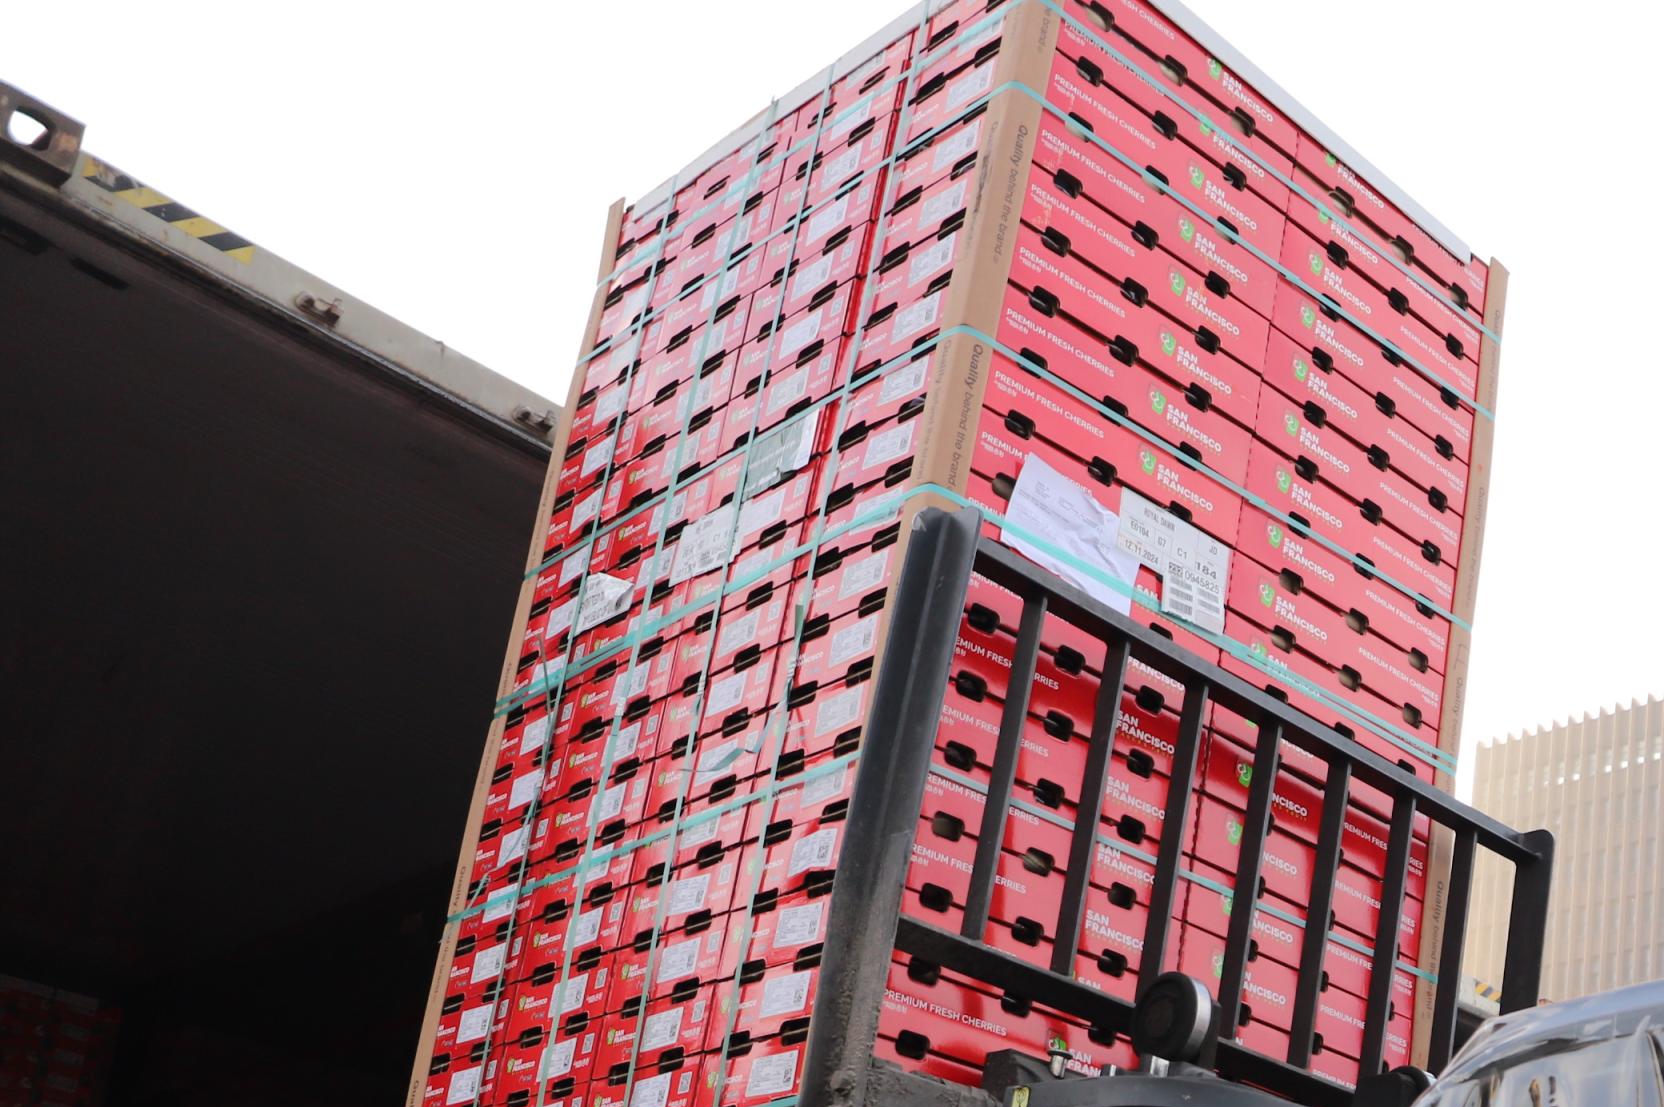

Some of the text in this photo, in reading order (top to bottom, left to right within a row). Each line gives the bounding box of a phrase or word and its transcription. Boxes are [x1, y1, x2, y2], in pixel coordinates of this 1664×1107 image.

[1138, 7, 1175, 40] CHERRIES
[1222, 72, 1243, 91] SAN
[1055, 74, 1092, 106] PREMIUM
[1093, 98, 1118, 124] FRESH
[1119, 117, 1157, 149] CHERRIES
[1221, 80, 1274, 122] FRANCISCO
[1010, 124, 1028, 167] Quality
[1212, 135, 1265, 178] FRANCISCO
[1042, 129, 1080, 161] PREMIUM
[1081, 155, 1106, 181] FRESH
[1107, 173, 1145, 203] CHERRIES
[1205, 180, 1225, 198] SAN
[1337, 166, 1385, 209] FRANCISCO
[1031, 184, 1069, 215] PREMIUM
[1070, 209, 1097, 235] FRESH
[1098, 227, 1136, 257] CHERRIES
[1205, 189, 1258, 230] FRANCISCO
[1195, 233, 1216, 252] SAN
[1331, 222, 1378, 264] FRANCISCO
[1195, 242, 1248, 283] FRANCISCO
[1324, 267, 1343, 284] SAN
[1020, 247, 1058, 277] PREMIUM
[1059, 271, 1086, 294] FRESH
[1087, 288, 1126, 318] CHERRIES
[1186, 286, 1207, 304] SAN
[1324, 275, 1372, 315] FRANCISCO
[1185, 294, 1240, 336] FRANCISCO
[1316, 320, 1335, 336] SAN
[1007, 308, 1047, 338] PREMIUM
[1047, 331, 1074, 354] FRESH
[1075, 349, 1115, 378] CHERRIES
[1177, 346, 1198, 364] SAN
[1315, 327, 1364, 367] FRANCISCO
[1176, 353, 1232, 395] FRANCISCO
[1309, 373, 1328, 390] SAN
[948, 344, 983, 486] Quality behind the brand
[994, 370, 1035, 401] PREMIUM
[1035, 392, 1064, 417] FRESH
[1064, 410, 1105, 439] CHERRIES
[1167, 403, 1188, 422] SAN
[1308, 380, 1358, 419] FRANCISCO
[981, 432, 1024, 460] PREMIUM
[1166, 412, 1222, 453] FRANCISCO
[1301, 427, 1320, 444] SAN
[1300, 435, 1350, 473] FRANCISCO
[1387, 428, 1464, 487] PREMIUM FRESH CHERRIES
[1156, 472, 1214, 512] FRANCISCO
[1157, 464, 1180, 483] SAN
[1292, 483, 1312, 500] SAN
[1291, 492, 1343, 528] FRANCISCO
[1380, 481, 1458, 540] PREMIUM FRESH CHERRIES
[1283, 546, 1335, 582] FRANCISCO
[1284, 538, 1304, 554] SAN
[1373, 536, 1452, 593] PREMIUM FRESH CHERRIES
[1275, 604, 1328, 640] FRANCISCO
[1276, 596, 1296, 612] SAN
[1366, 589, 1445, 646] PREMIUM FRESH CHERRIES
[955, 637, 985, 657] EMIUM
[1034, 673, 1060, 690] RRIES
[1127, 656, 1186, 692] FRANCISCO
[1359, 647, 1439, 701] PREMIUM FRESH CHERRIES
[942, 705, 974, 725] EMIUM
[1020, 738, 1049, 757] ERRIES
[1118, 710, 1139, 727] SAN
[1116, 722, 1175, 755] FRANCISCO
[927, 774, 1040, 826] REMIUM FRES ERRIES
[1106, 787, 1165, 820] FRANCISCO
[1107, 776, 1129, 793] SAN
[1272, 793, 1308, 817] NCISCO
[912, 844, 1027, 894] REMIUM FRES ERRIES
[1098, 843, 1121, 860] SAN
[1263, 852, 1297, 876] NCISCO
[1087, 910, 1109, 926] SAN
[1433, 881, 1443, 923] Quality
[1243, 981, 1286, 1005] ANCISCO
[884, 989, 1007, 1037] PREMIUM FRESH CHERRIES
[1320, 1004, 1353, 1025] PREMIUM
[1068, 1049, 1092, 1063] SAN
